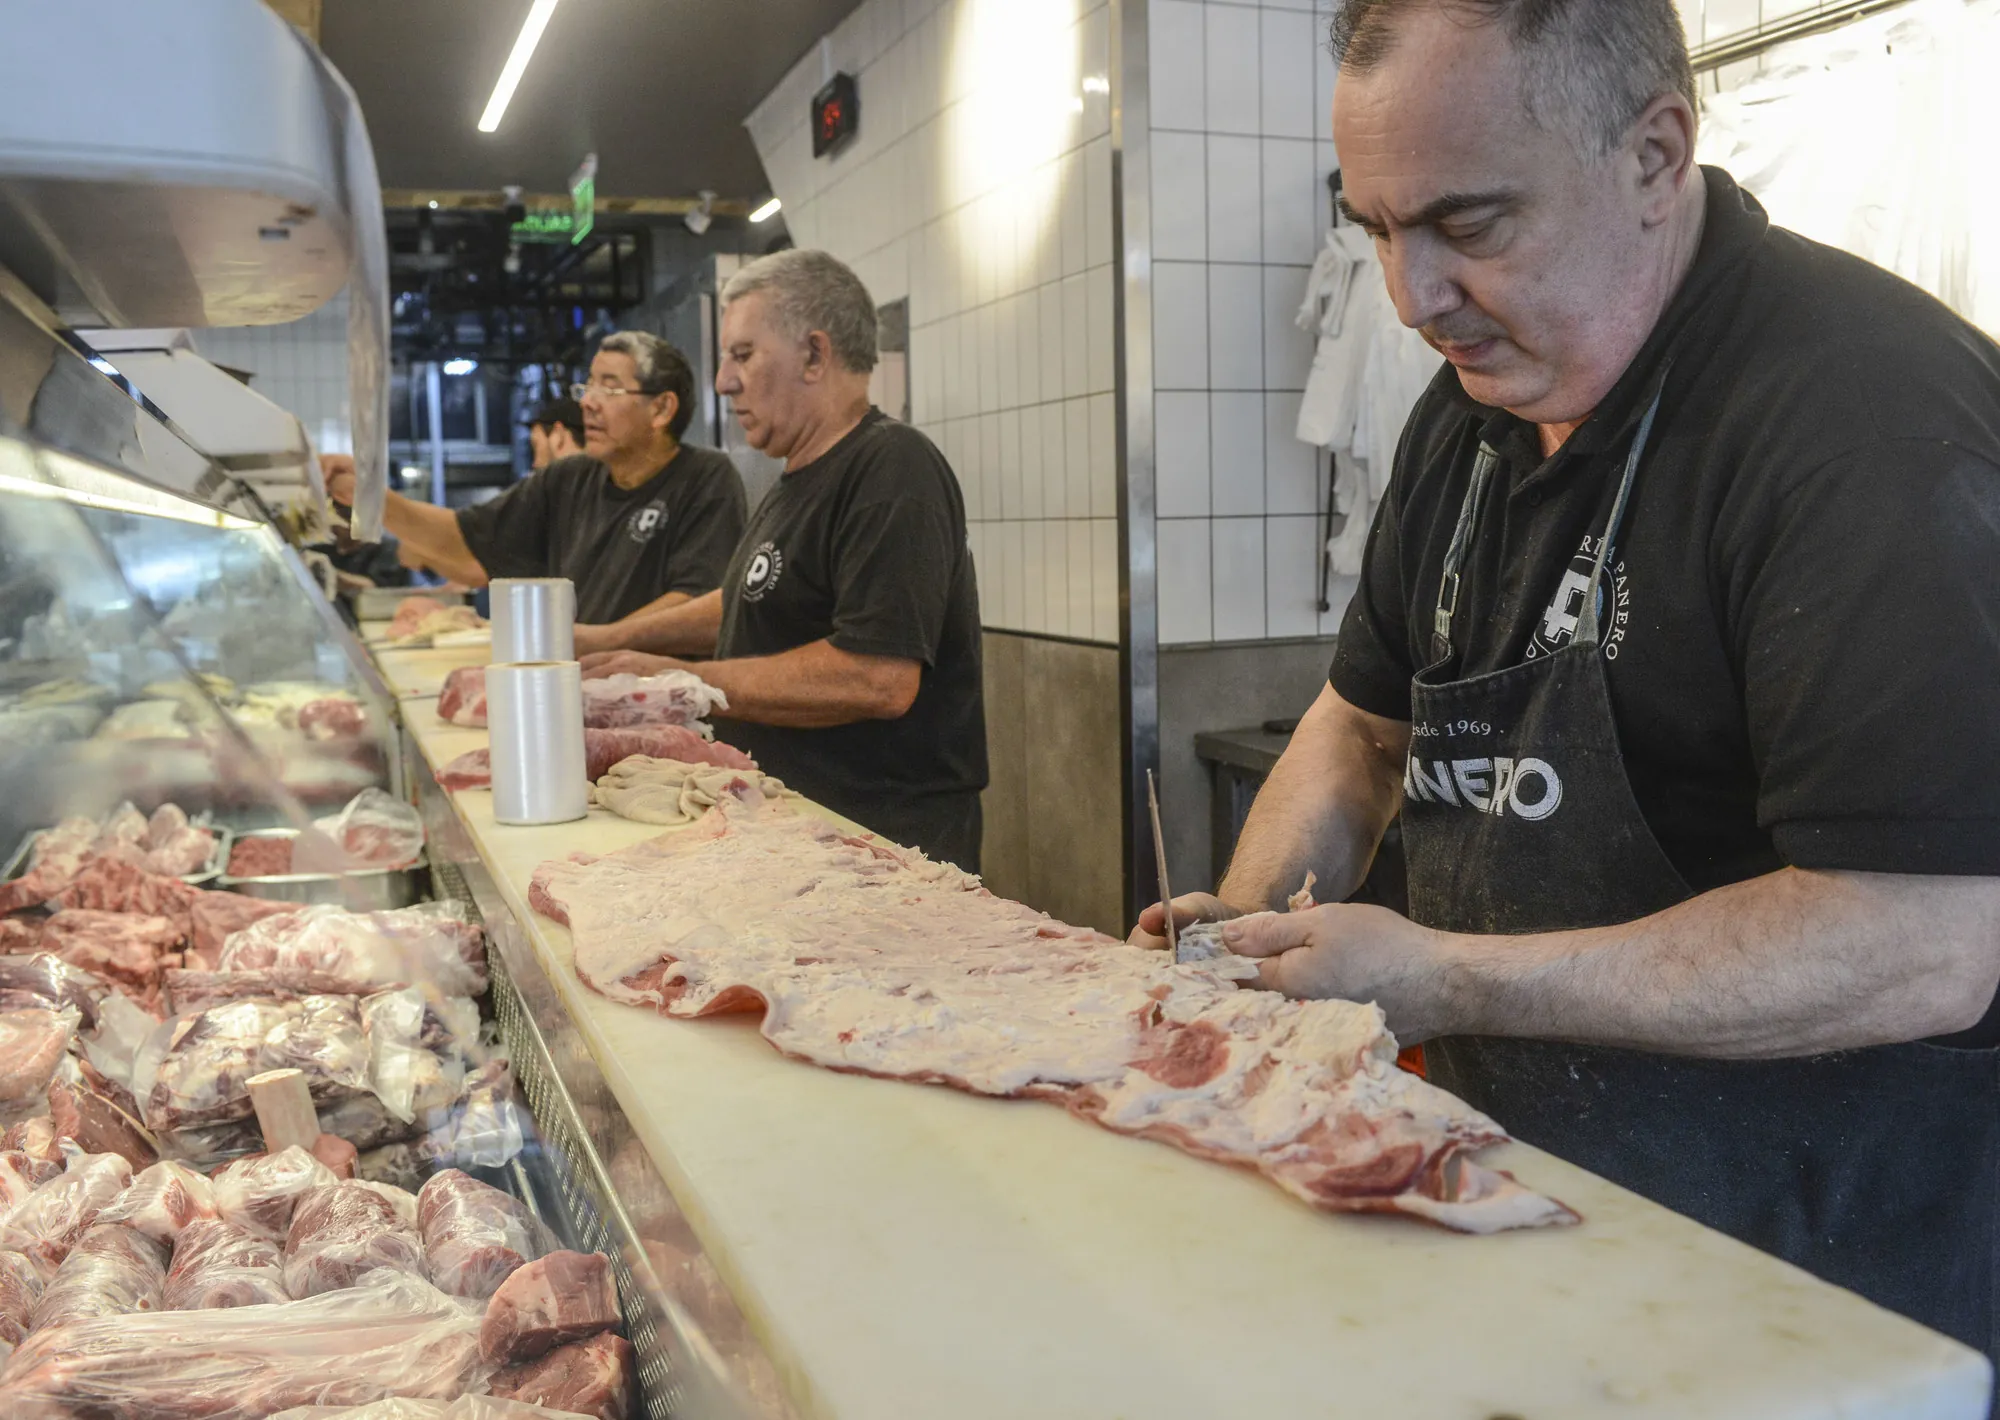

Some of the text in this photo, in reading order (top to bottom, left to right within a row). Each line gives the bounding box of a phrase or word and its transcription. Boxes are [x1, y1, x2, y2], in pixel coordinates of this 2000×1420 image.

[746, 554, 769, 586] P
[1605, 561, 1629, 660] PANERO
[1444, 719, 1492, 737] 1969
